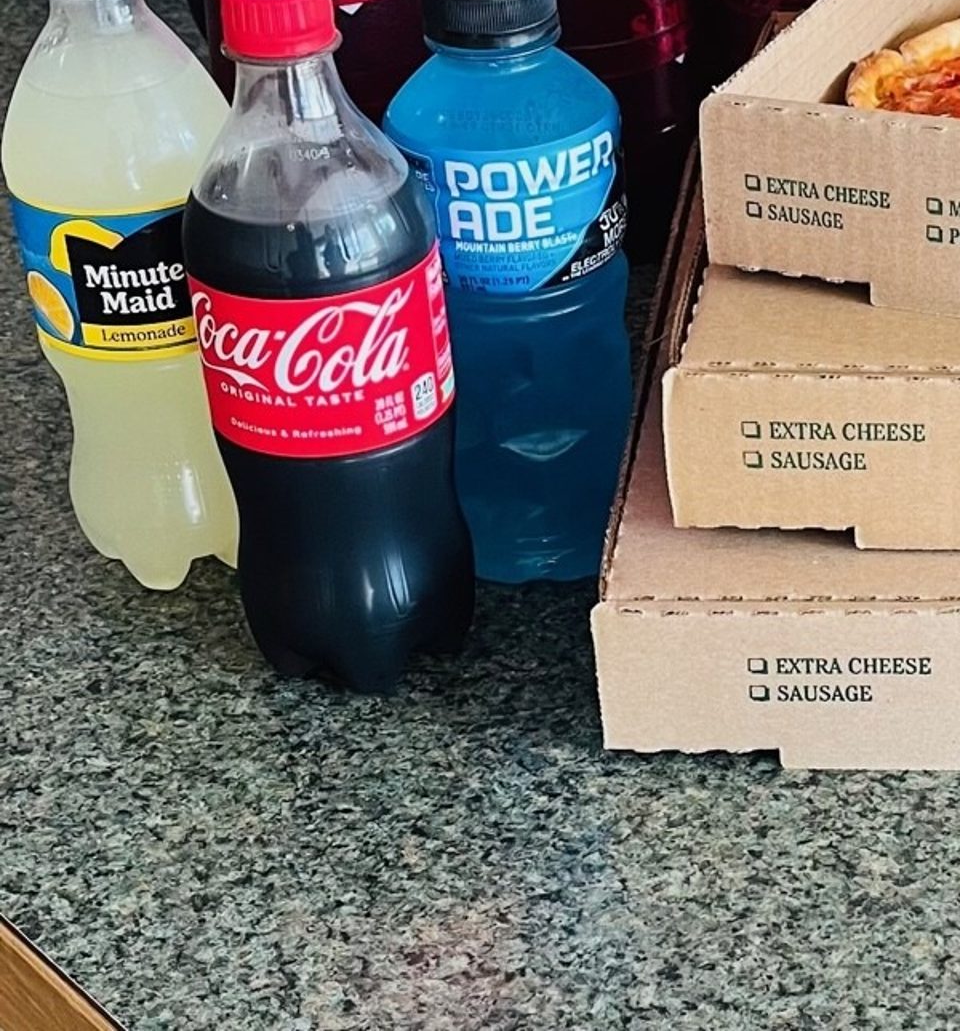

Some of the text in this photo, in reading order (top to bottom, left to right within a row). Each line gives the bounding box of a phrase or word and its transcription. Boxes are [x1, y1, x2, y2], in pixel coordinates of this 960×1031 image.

[445, 131, 613, 200] POWER
[767, 176, 891, 209] EXTRA CHEESE
[448, 196, 556, 241] ADE
[767, 205, 844, 230] SAUSAGE
[455, 241, 506, 253] MOUNTAIN
[508, 239, 541, 253] BERRY
[83, 261, 185, 288] Minute
[100, 285, 176, 314] Maid
[102, 322, 186, 343] Lemonade
[191, 280, 415, 394] Coca-Cola
[220, 381, 297, 407] ORIGINAL
[304, 389, 364, 406] TASTE
[231, 417, 277, 436] Delicious
[292, 425, 362, 439] Refreshing
[768, 422, 926, 442] EXTRA CHEESE
[770, 451, 867, 471] SAUSAGE
[775, 657, 932, 675] EXTRA CHEESE
[776, 684, 873, 702] SAUSAGE
